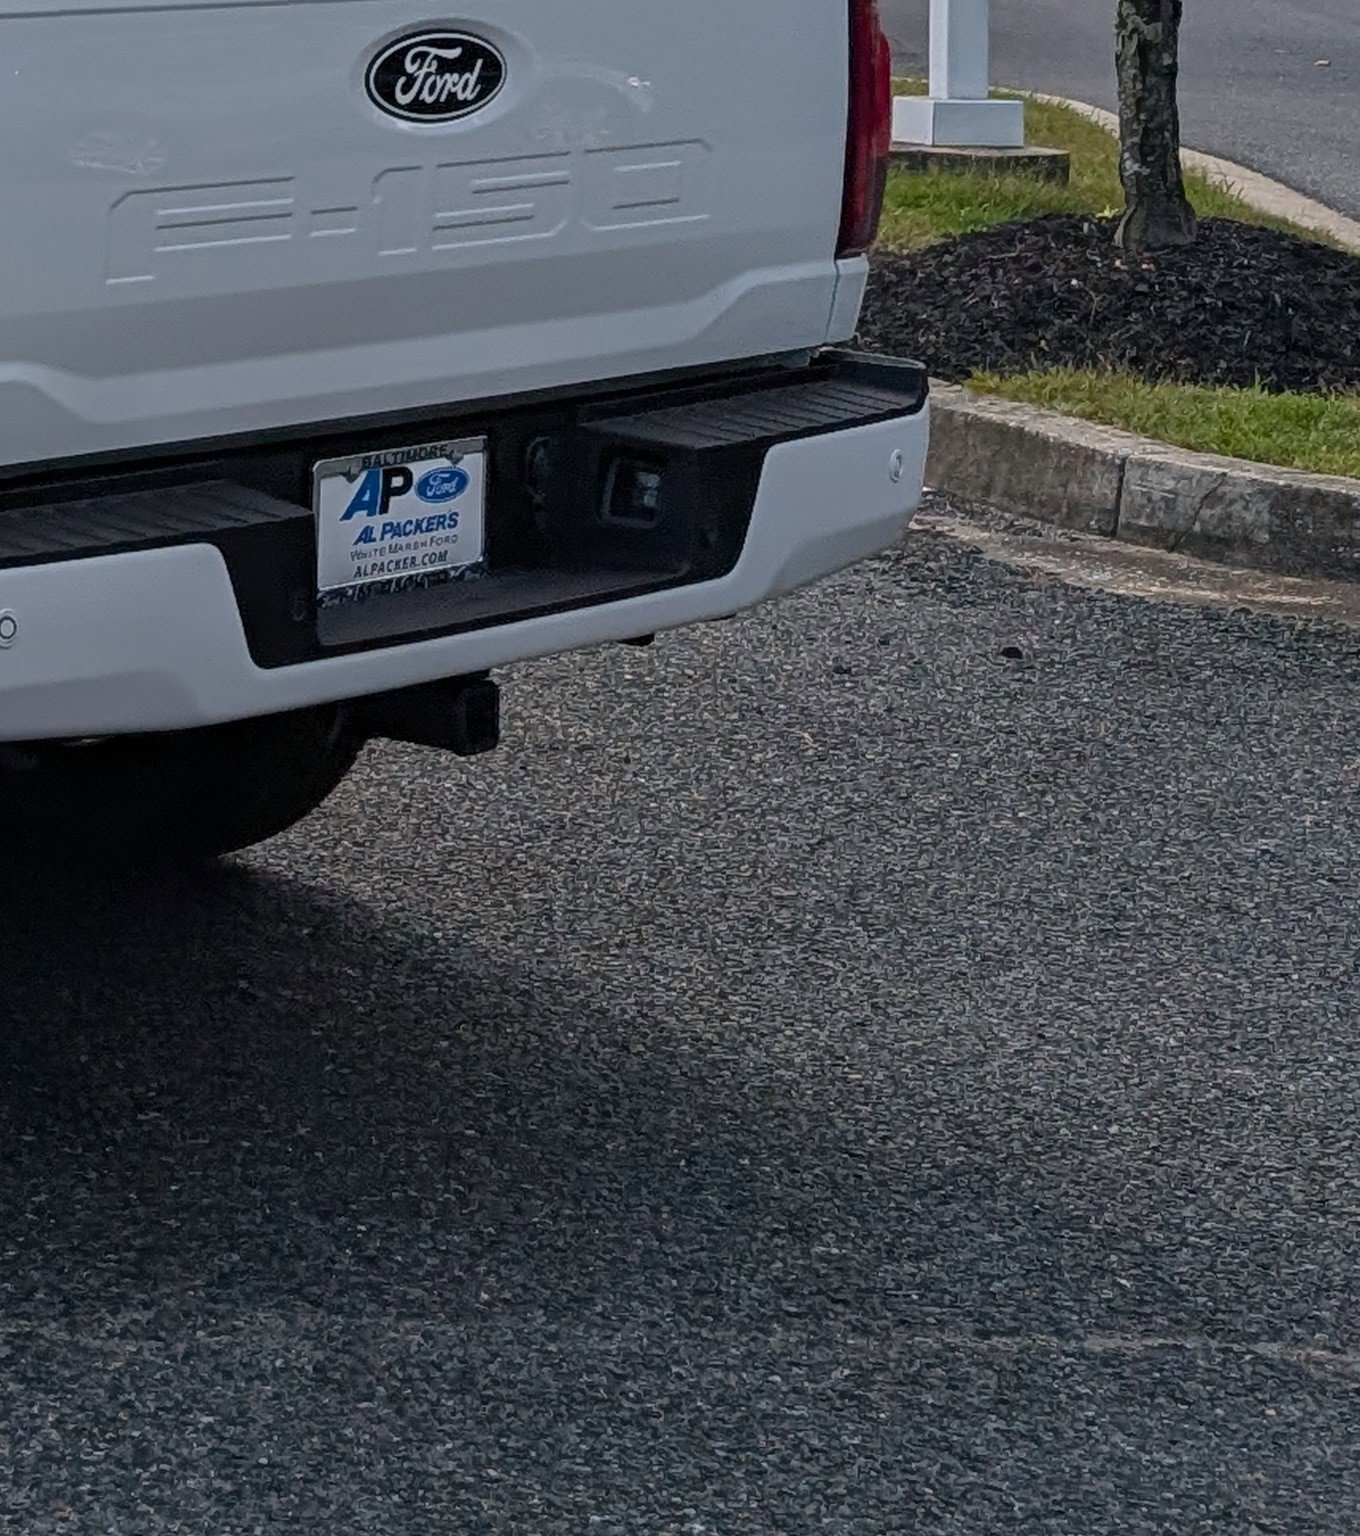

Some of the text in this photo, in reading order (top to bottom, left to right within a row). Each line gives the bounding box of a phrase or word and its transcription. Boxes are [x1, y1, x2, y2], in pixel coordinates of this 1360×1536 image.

[394, 45, 484, 106] Ford
[105, 138, 714, 284] F-150
[339, 466, 414, 522] AP
[425, 473, 460, 497] Ford
[352, 509, 460, 546] AL PACKER'S
[352, 550, 449, 579] ALPACKER.COM
